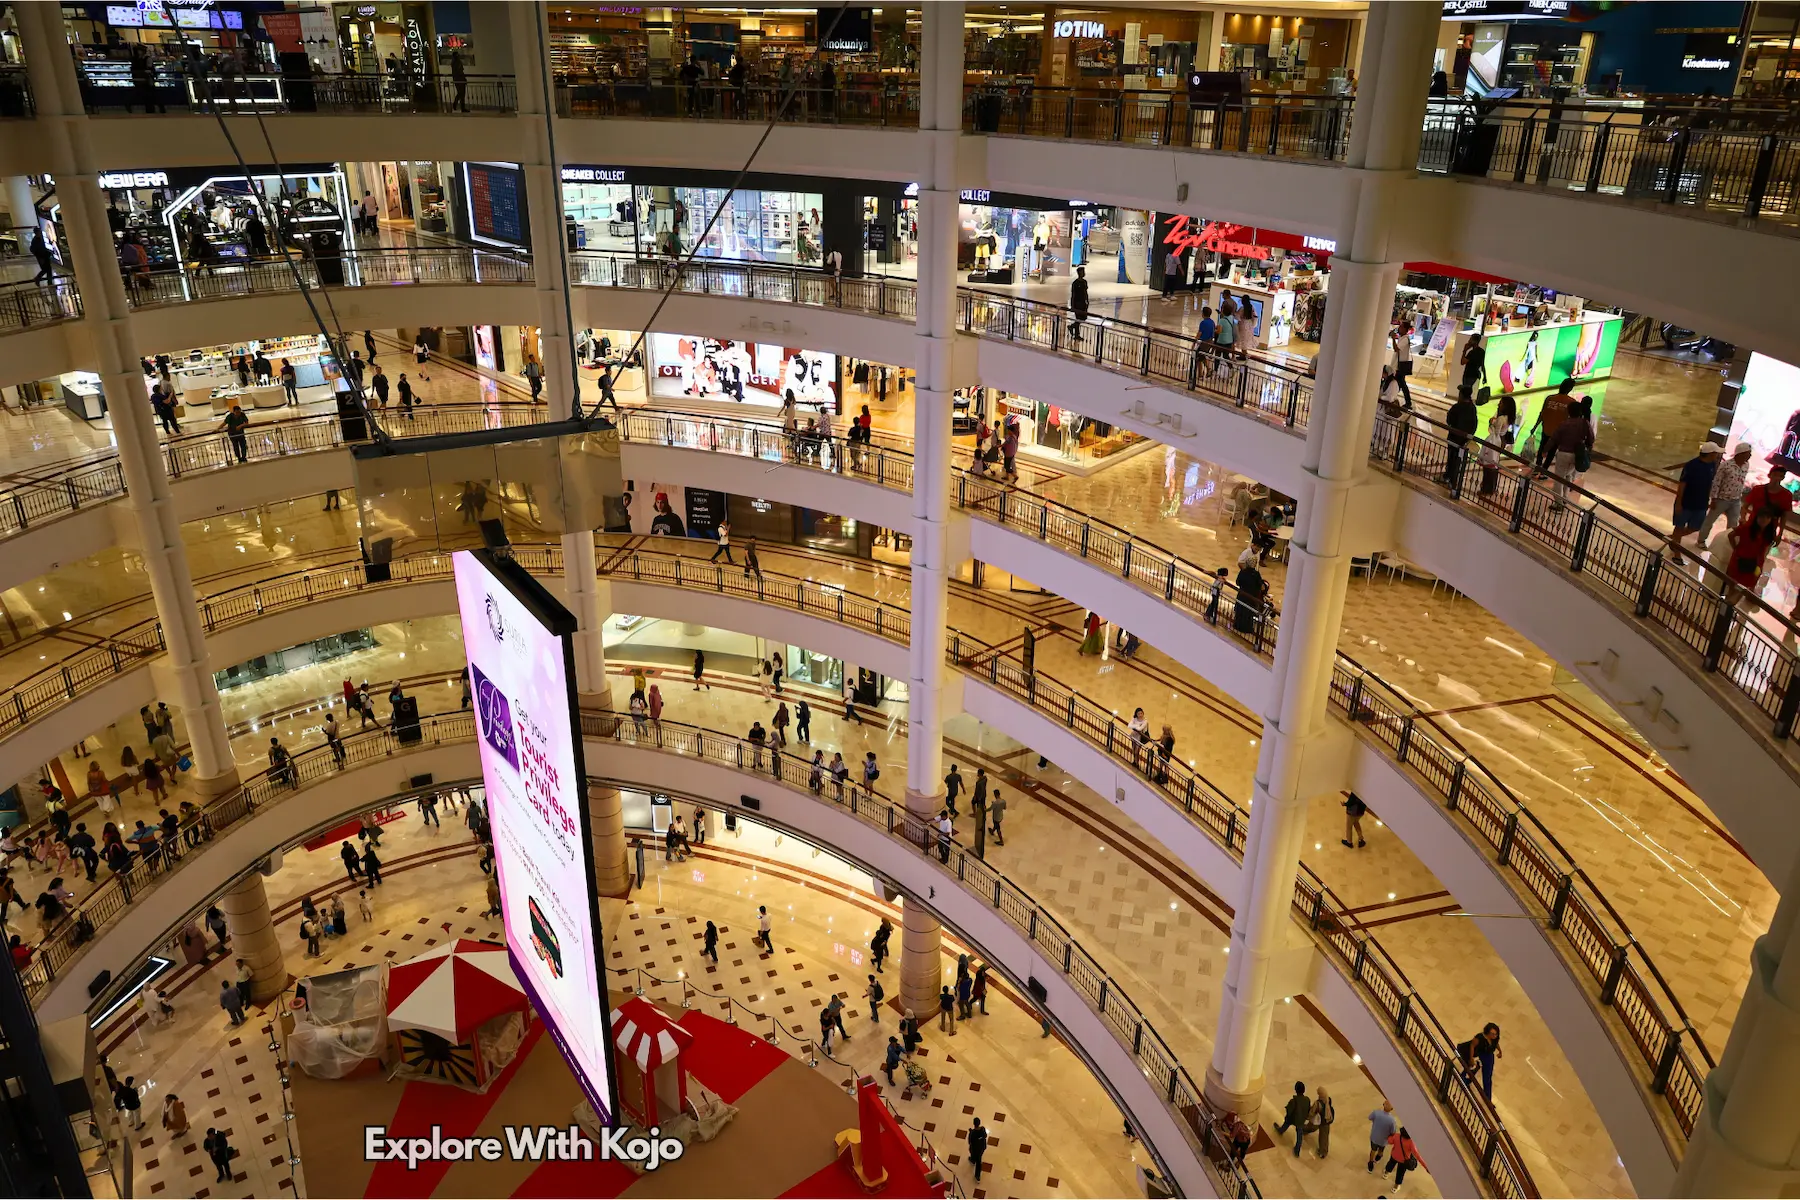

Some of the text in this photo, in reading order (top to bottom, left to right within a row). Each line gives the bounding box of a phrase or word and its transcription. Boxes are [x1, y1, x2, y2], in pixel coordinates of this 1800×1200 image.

[561, 169, 625, 181] SNEAKER COLLECT
[961, 190, 990, 202] COLLECT
[320, 233, 330, 246] 3
[1206, 235, 1269, 260] Cinemas
[345, 393, 354, 405] 2
[401, 702, 410, 712] G
[514, 698, 547, 745] Get your
[517, 721, 560, 791] Tourist
[522, 752, 576, 839] Privilege
[525, 780, 575, 862] Card today
